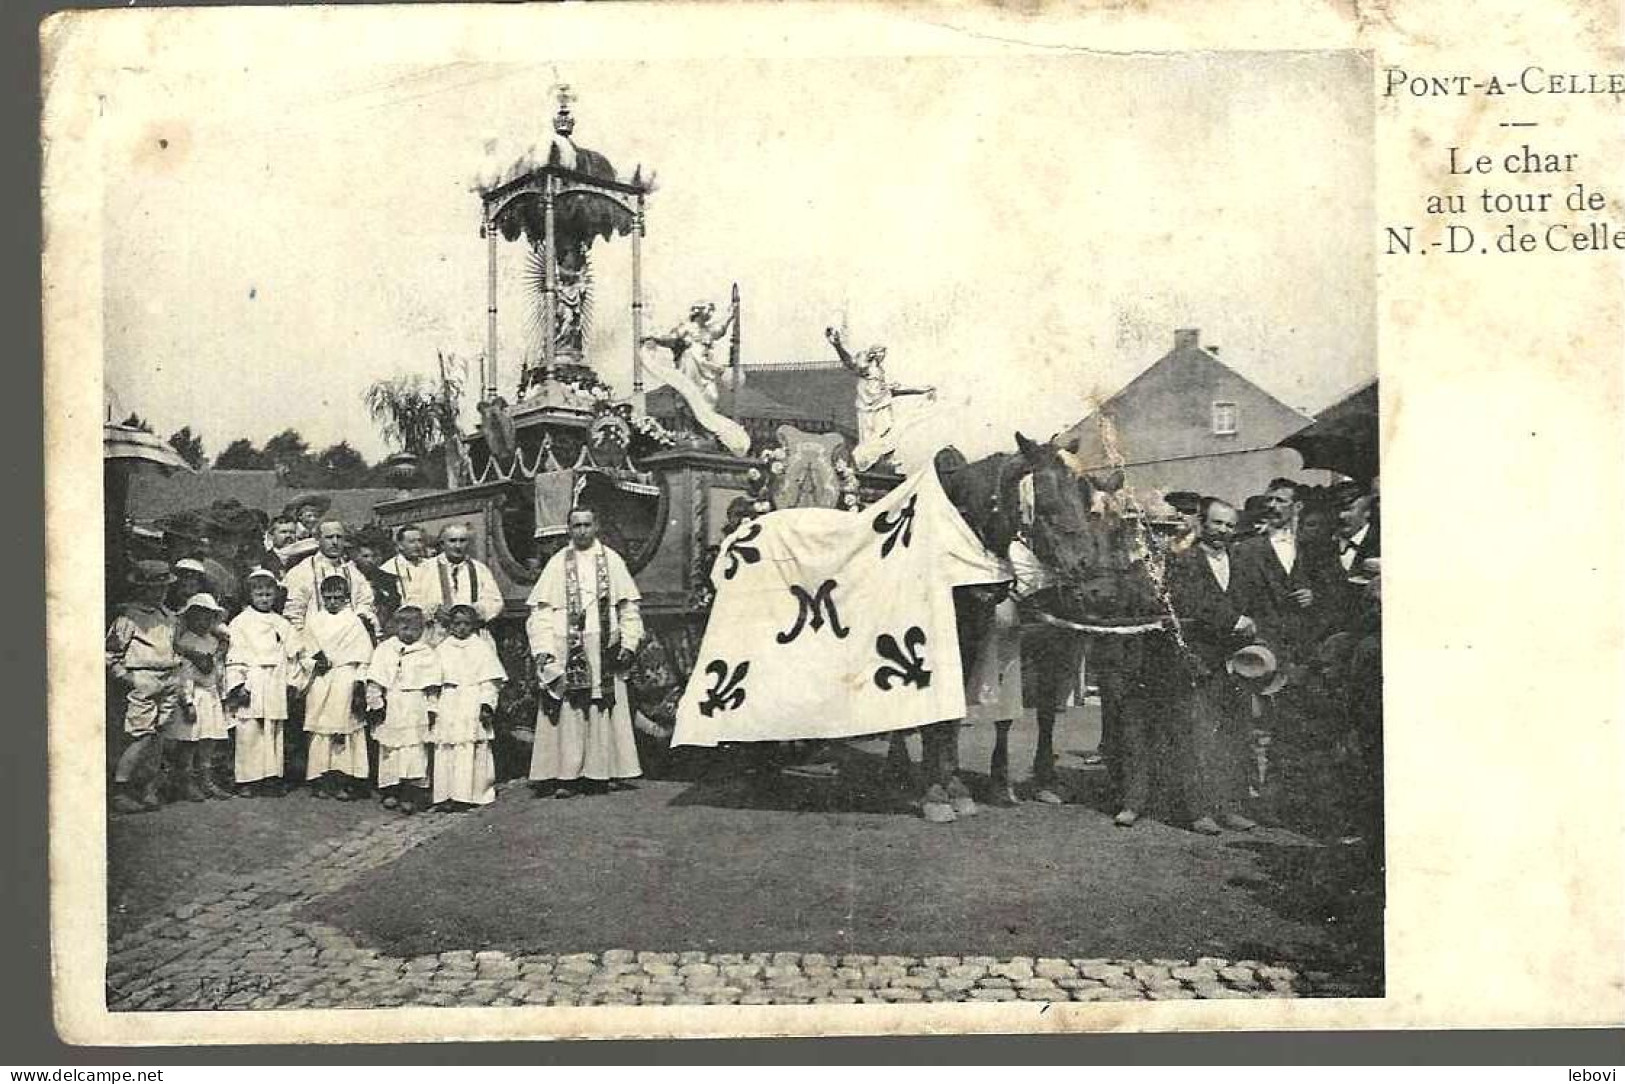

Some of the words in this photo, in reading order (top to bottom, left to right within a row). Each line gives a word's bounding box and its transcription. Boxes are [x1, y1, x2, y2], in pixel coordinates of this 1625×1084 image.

[1447, 146, 1493, 175] Le
[1503, 144, 1579, 174] char
[1426, 195, 1466, 214] au
[1480, 188, 1553, 213] tour
[1566, 183, 1606, 211] de
[1496, 224, 1537, 253] de
[1545, 222, 1625, 252] Celle
[776, 579, 850, 645] M
